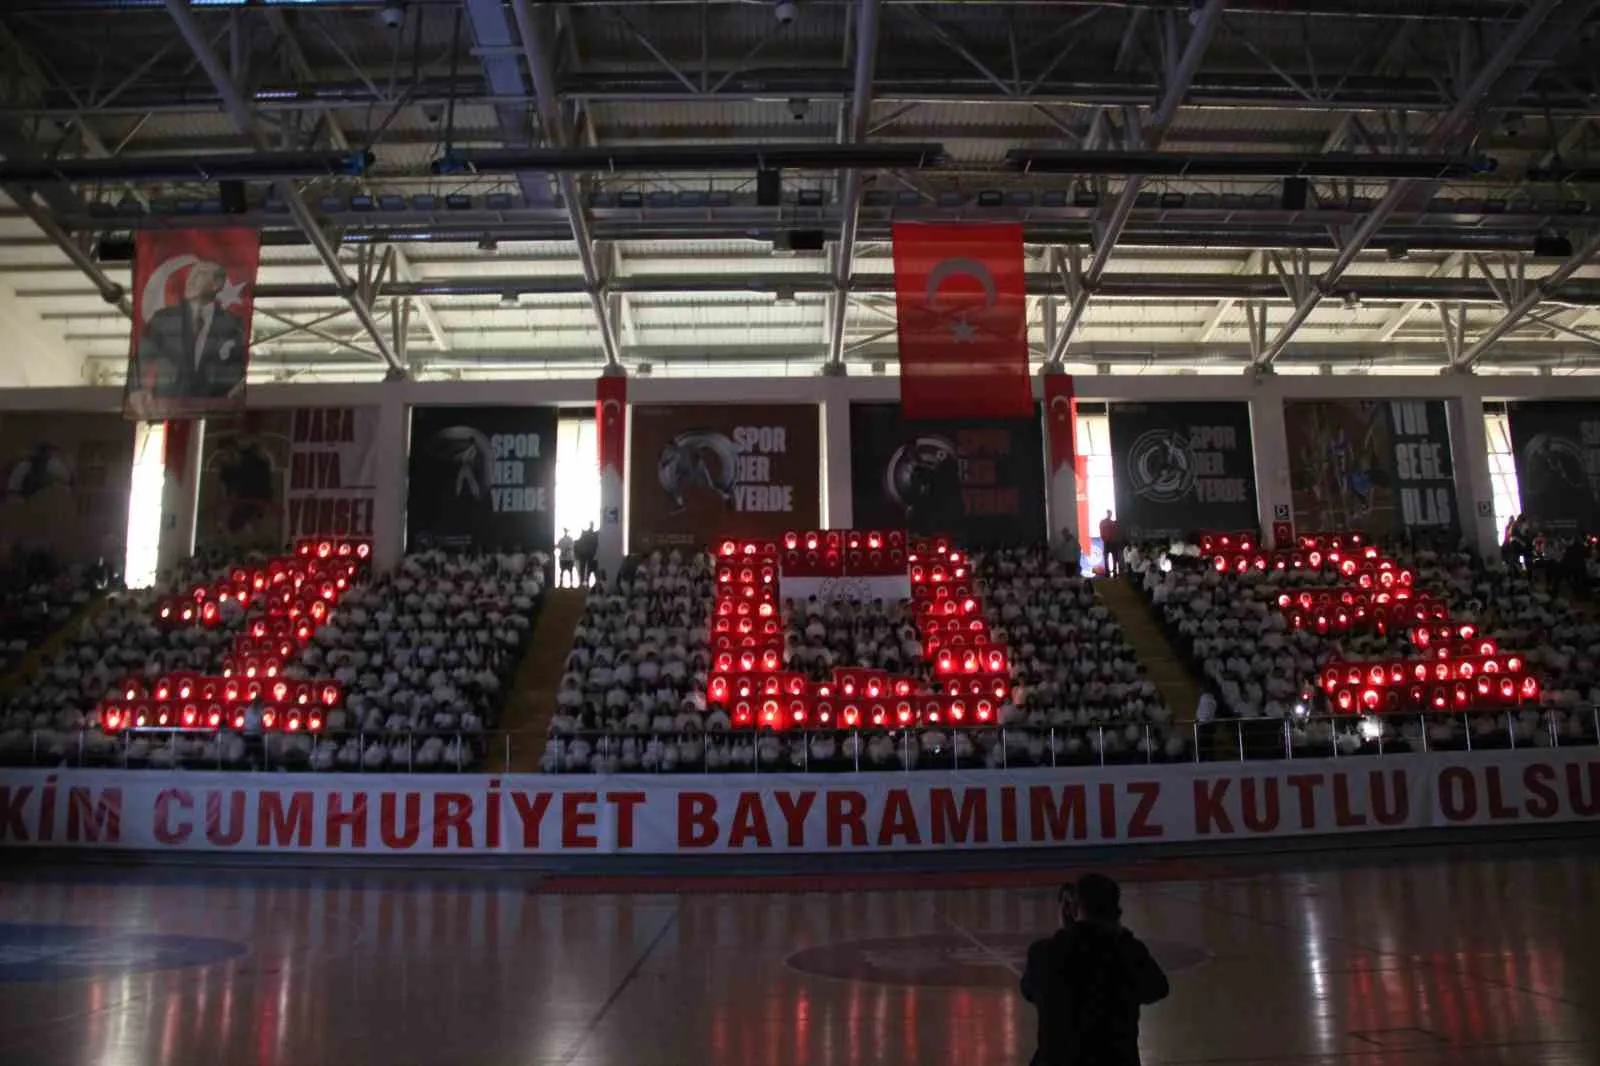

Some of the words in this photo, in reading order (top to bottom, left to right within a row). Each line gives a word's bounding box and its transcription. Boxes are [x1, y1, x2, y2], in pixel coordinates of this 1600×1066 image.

[491, 432, 541, 458] SPOR
[733, 426, 786, 453] SPOR
[1189, 425, 1236, 451] SPOR
[492, 461, 524, 484] HER
[736, 455, 770, 482] HER
[490, 487, 546, 512] YERDE
[734, 485, 793, 512] YERDE
[1196, 478, 1248, 503] YERDE
[0, 775, 122, 842] KİM
[154, 779, 646, 849] CUMHURİYET
[677, 782, 1164, 848] BAYRAMIMIZ
[1194, 770, 1409, 834] KUTLU
